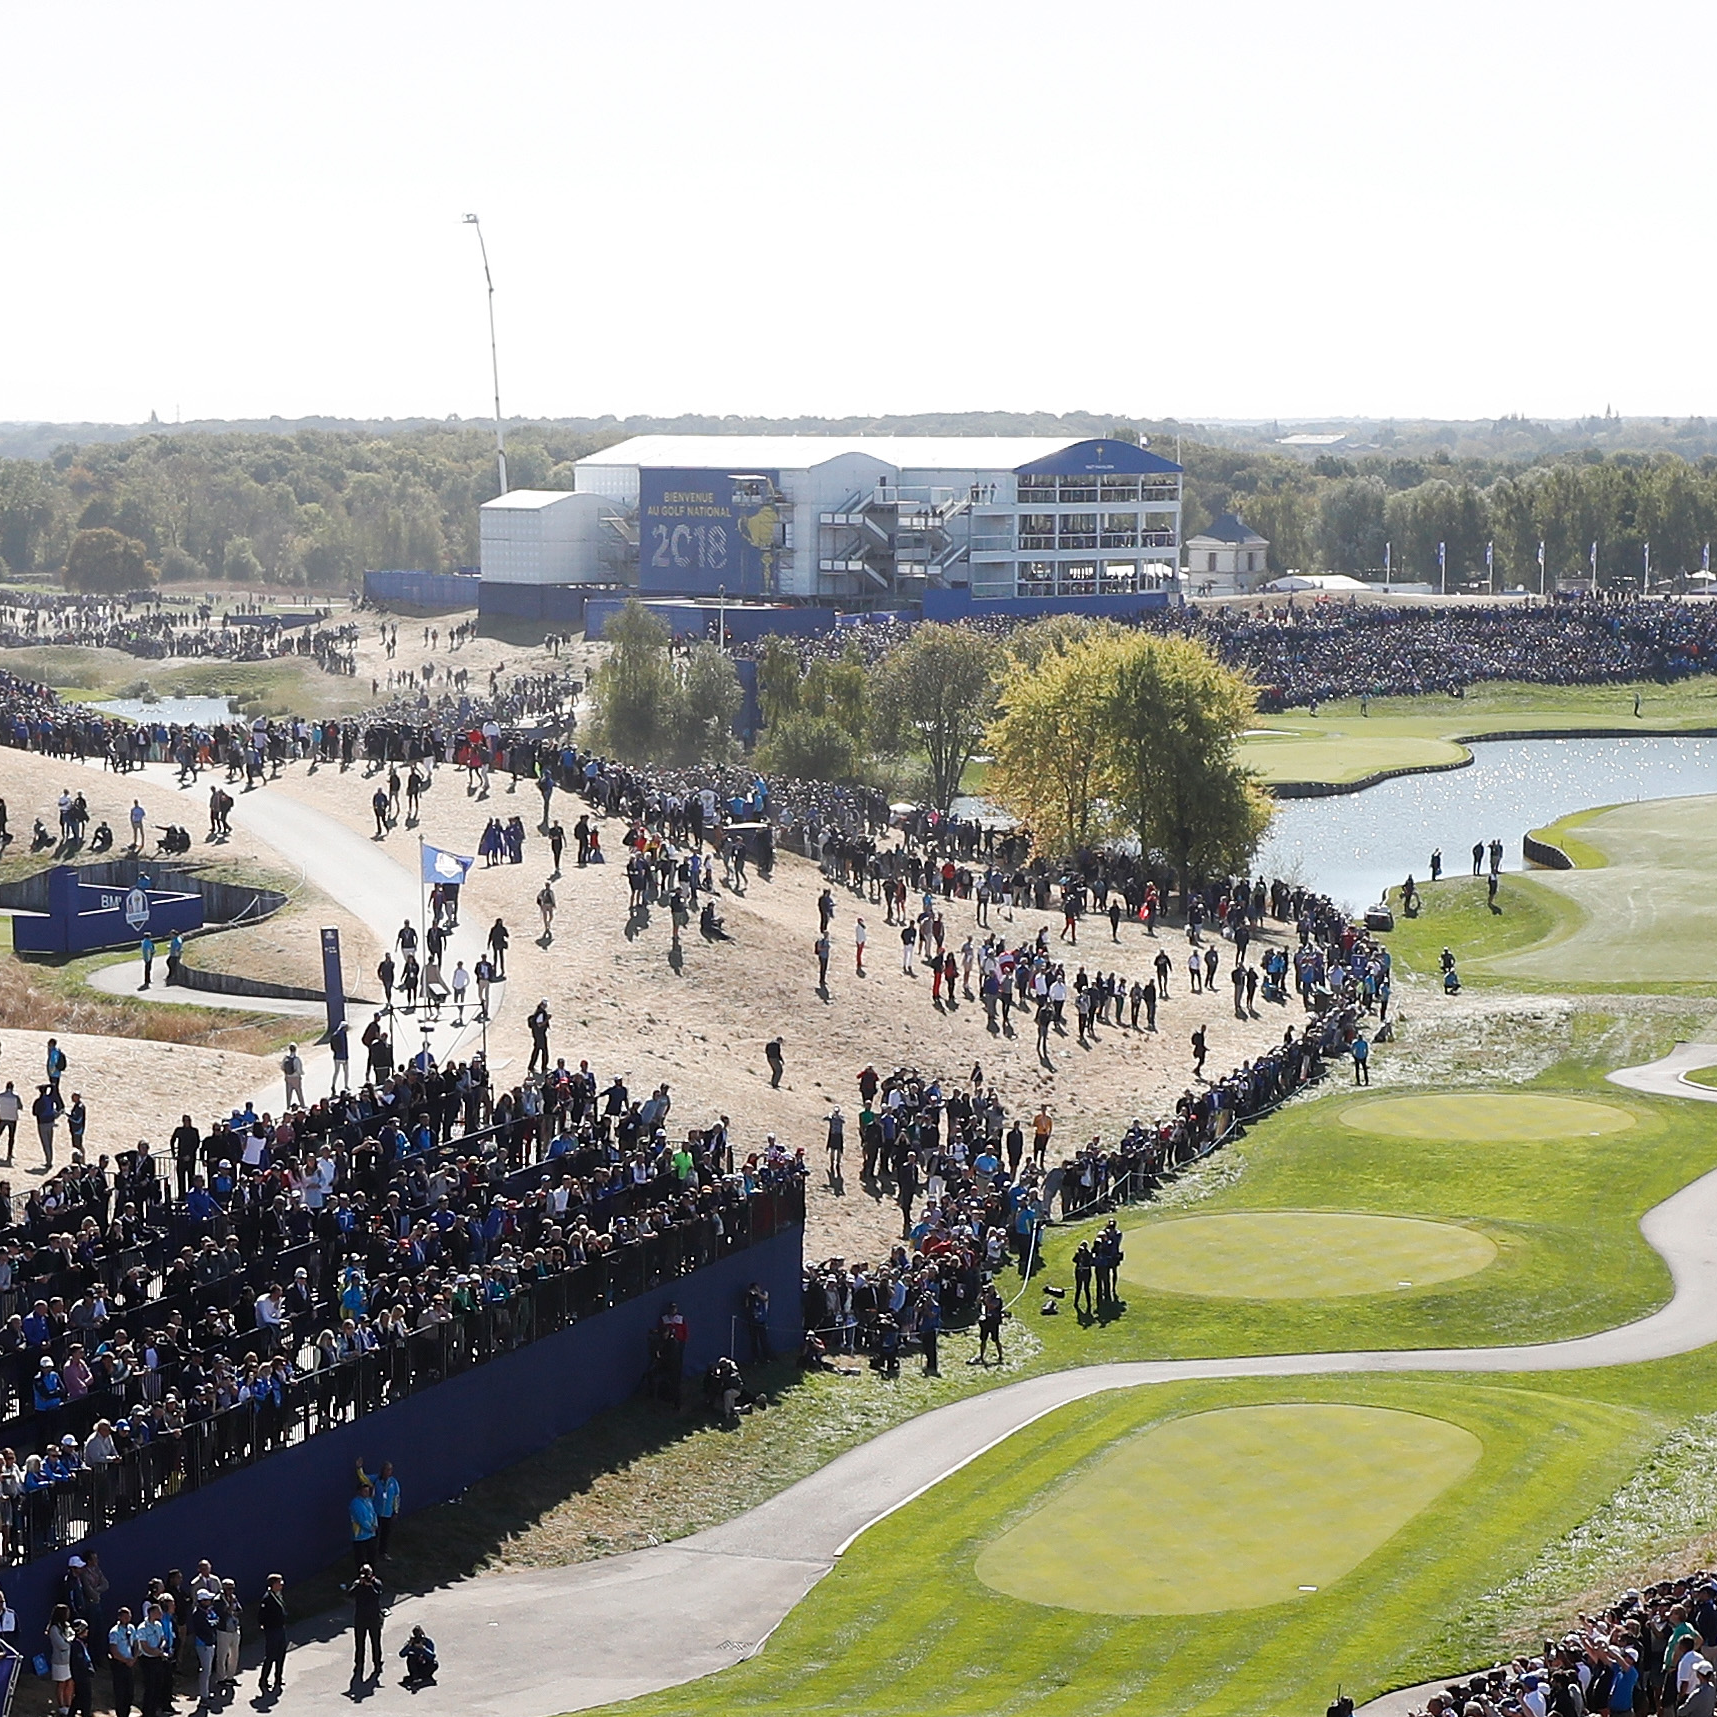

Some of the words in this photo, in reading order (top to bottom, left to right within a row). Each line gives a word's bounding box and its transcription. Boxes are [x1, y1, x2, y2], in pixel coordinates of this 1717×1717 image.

[664, 492, 714, 503] BIENVENUE
[648, 506, 660, 515] AU
[661, 506, 685, 517] GOLF
[687, 507, 732, 518] NATIONAL
[651, 524, 728, 569] 2018
[101, 895, 122, 908] BM
